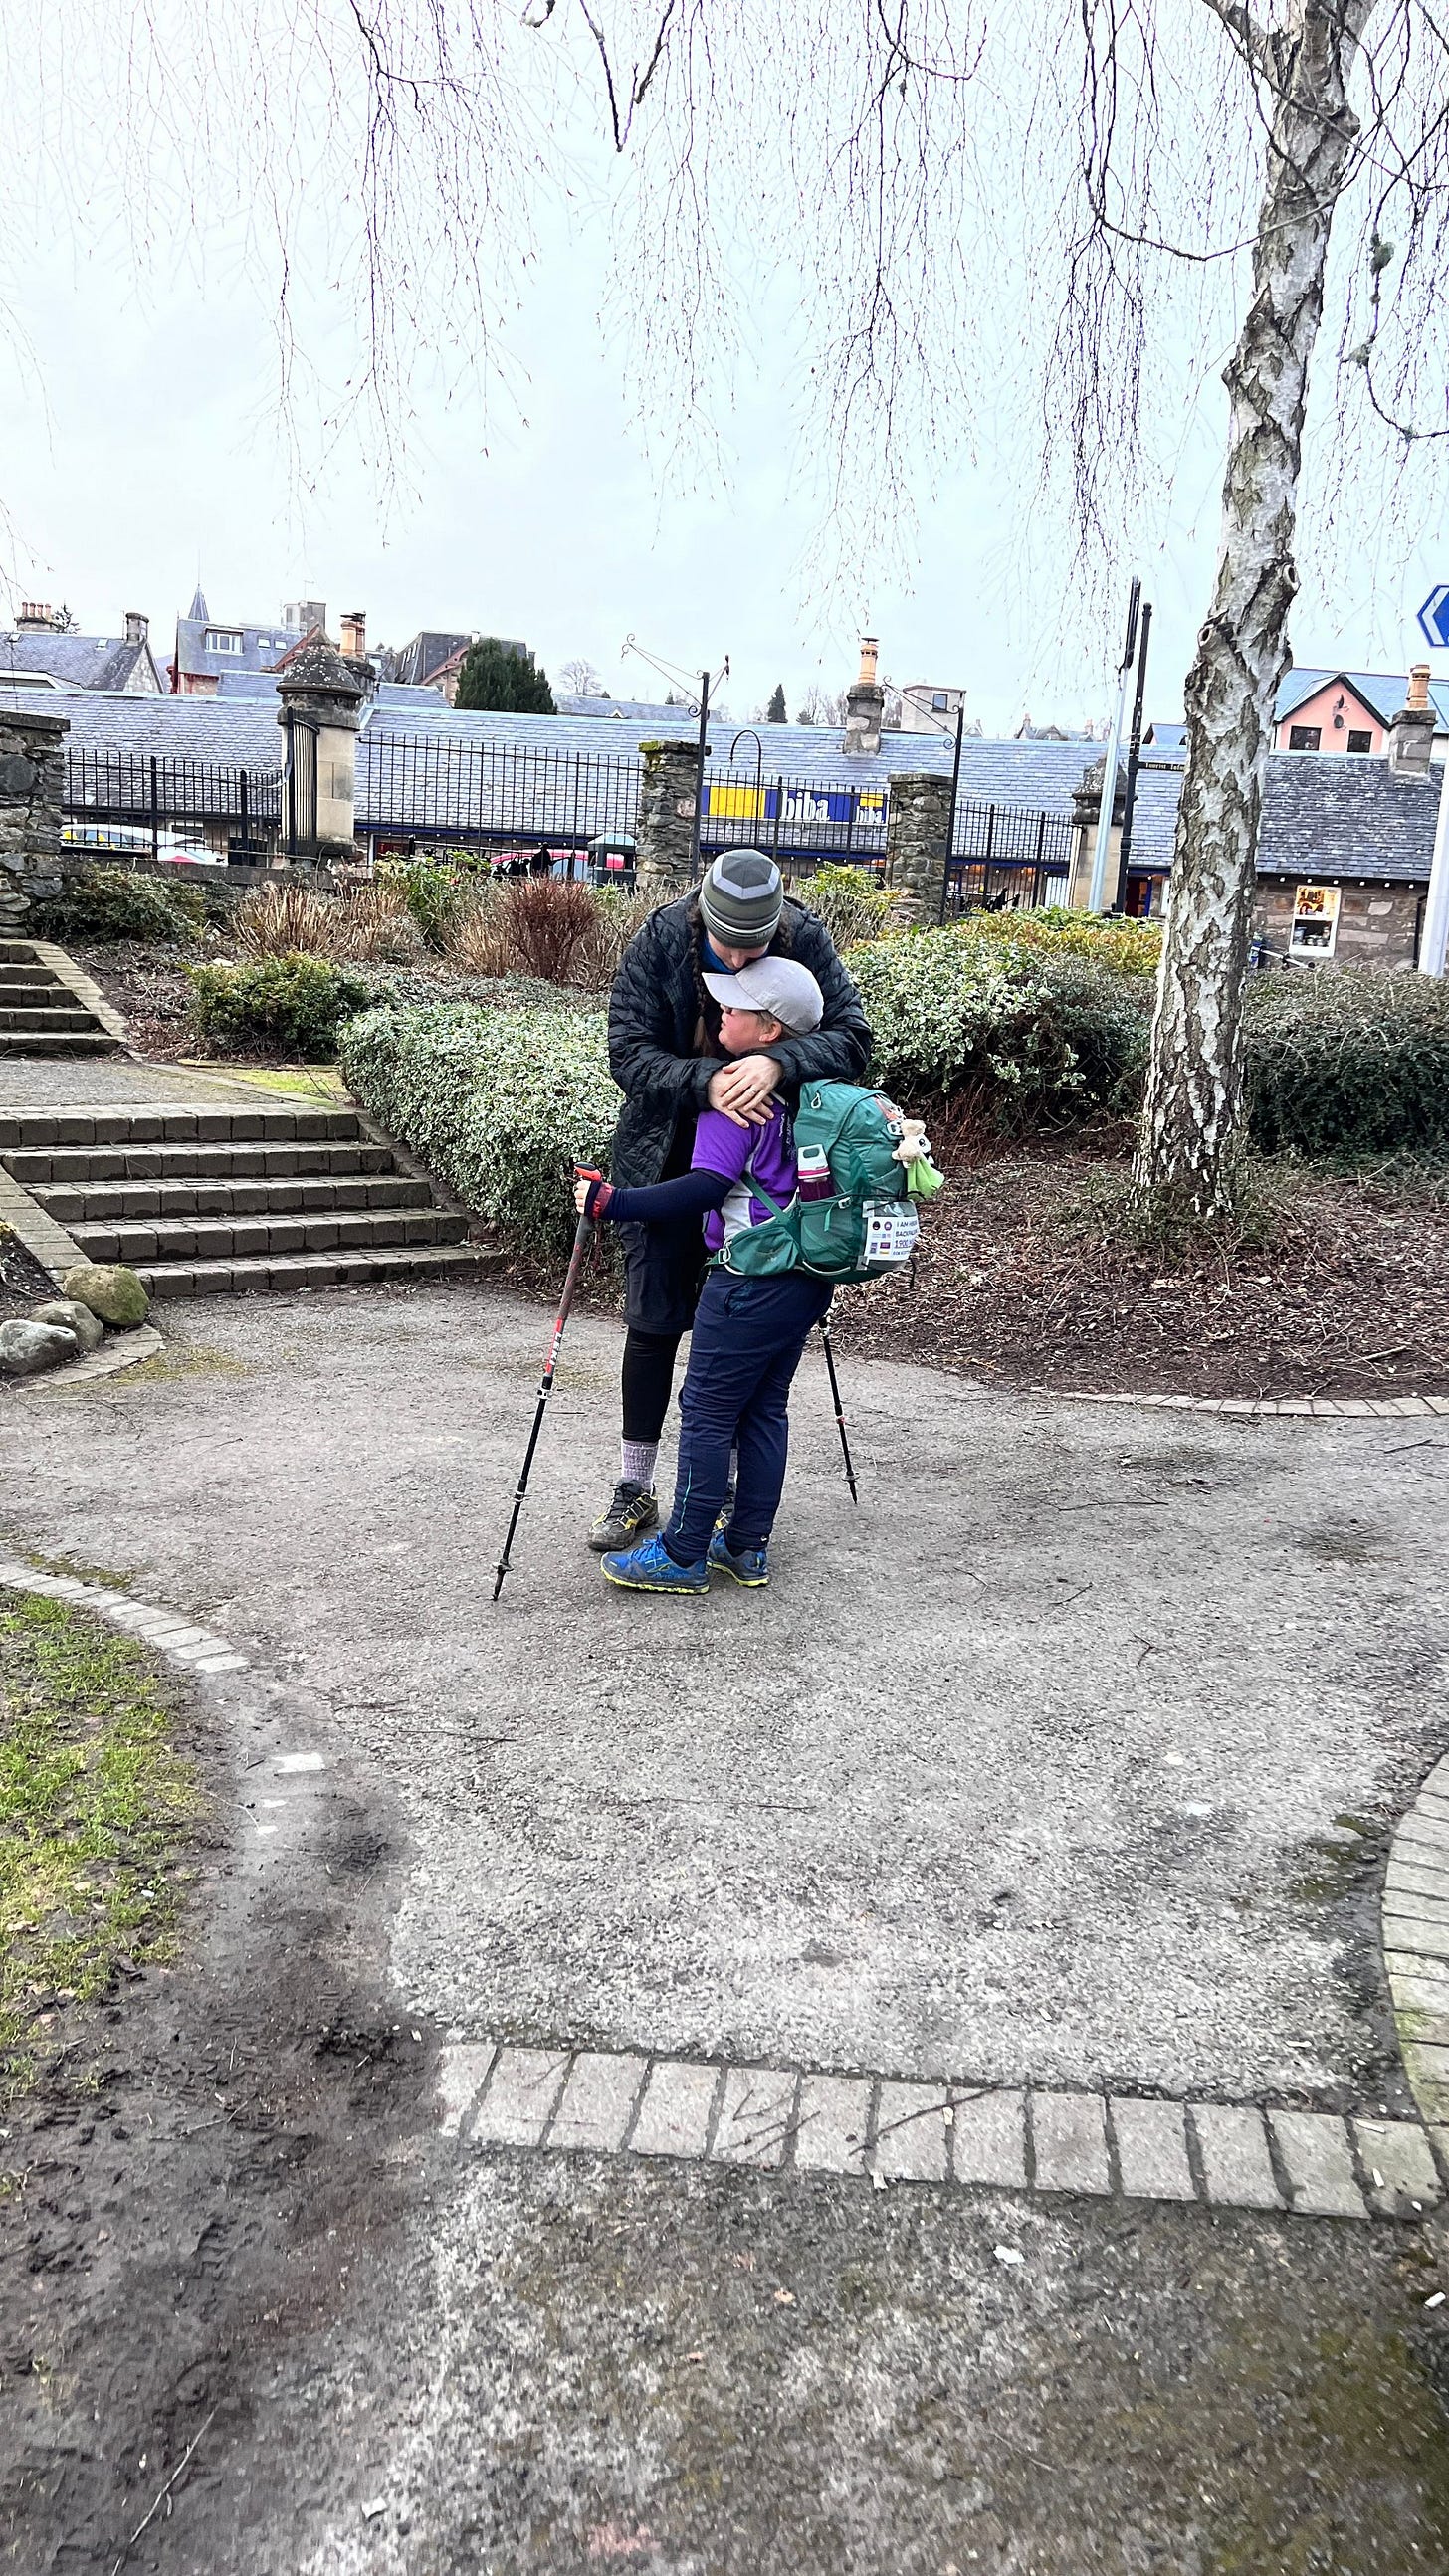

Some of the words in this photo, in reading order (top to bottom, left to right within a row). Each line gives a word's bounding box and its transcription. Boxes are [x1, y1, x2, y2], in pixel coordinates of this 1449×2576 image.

[780, 791, 830, 822] biba
[856, 805, 884, 824] biba
[549, 1332, 562, 1366] LEKI
